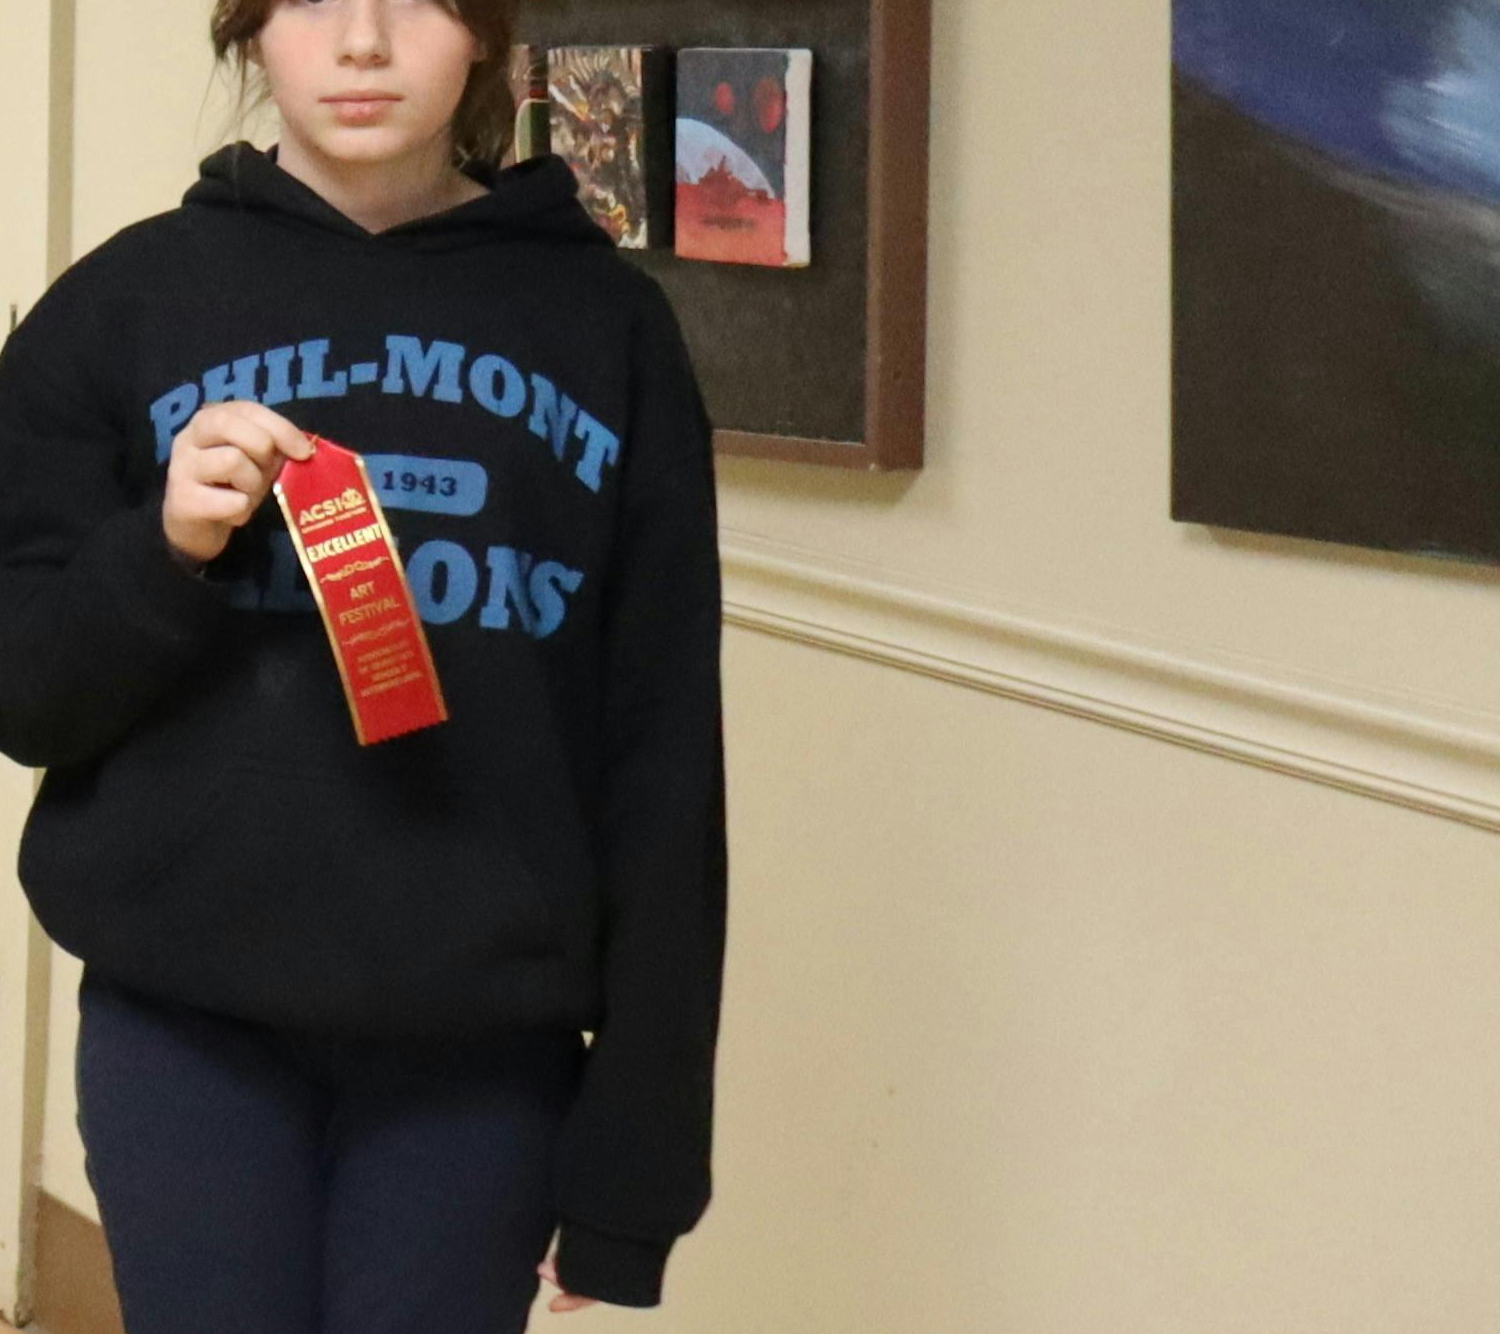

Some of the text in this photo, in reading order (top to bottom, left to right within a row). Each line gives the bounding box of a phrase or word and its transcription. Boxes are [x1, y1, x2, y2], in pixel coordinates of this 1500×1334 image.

[149, 334, 620, 494] PHIL-MONT
[381, 468, 460, 497] 1943
[300, 496, 345, 526] ACSI
[306, 522, 382, 563] EXCELLENT
[349, 580, 375, 601] ART
[338, 595, 402, 625] FESTIVAL
